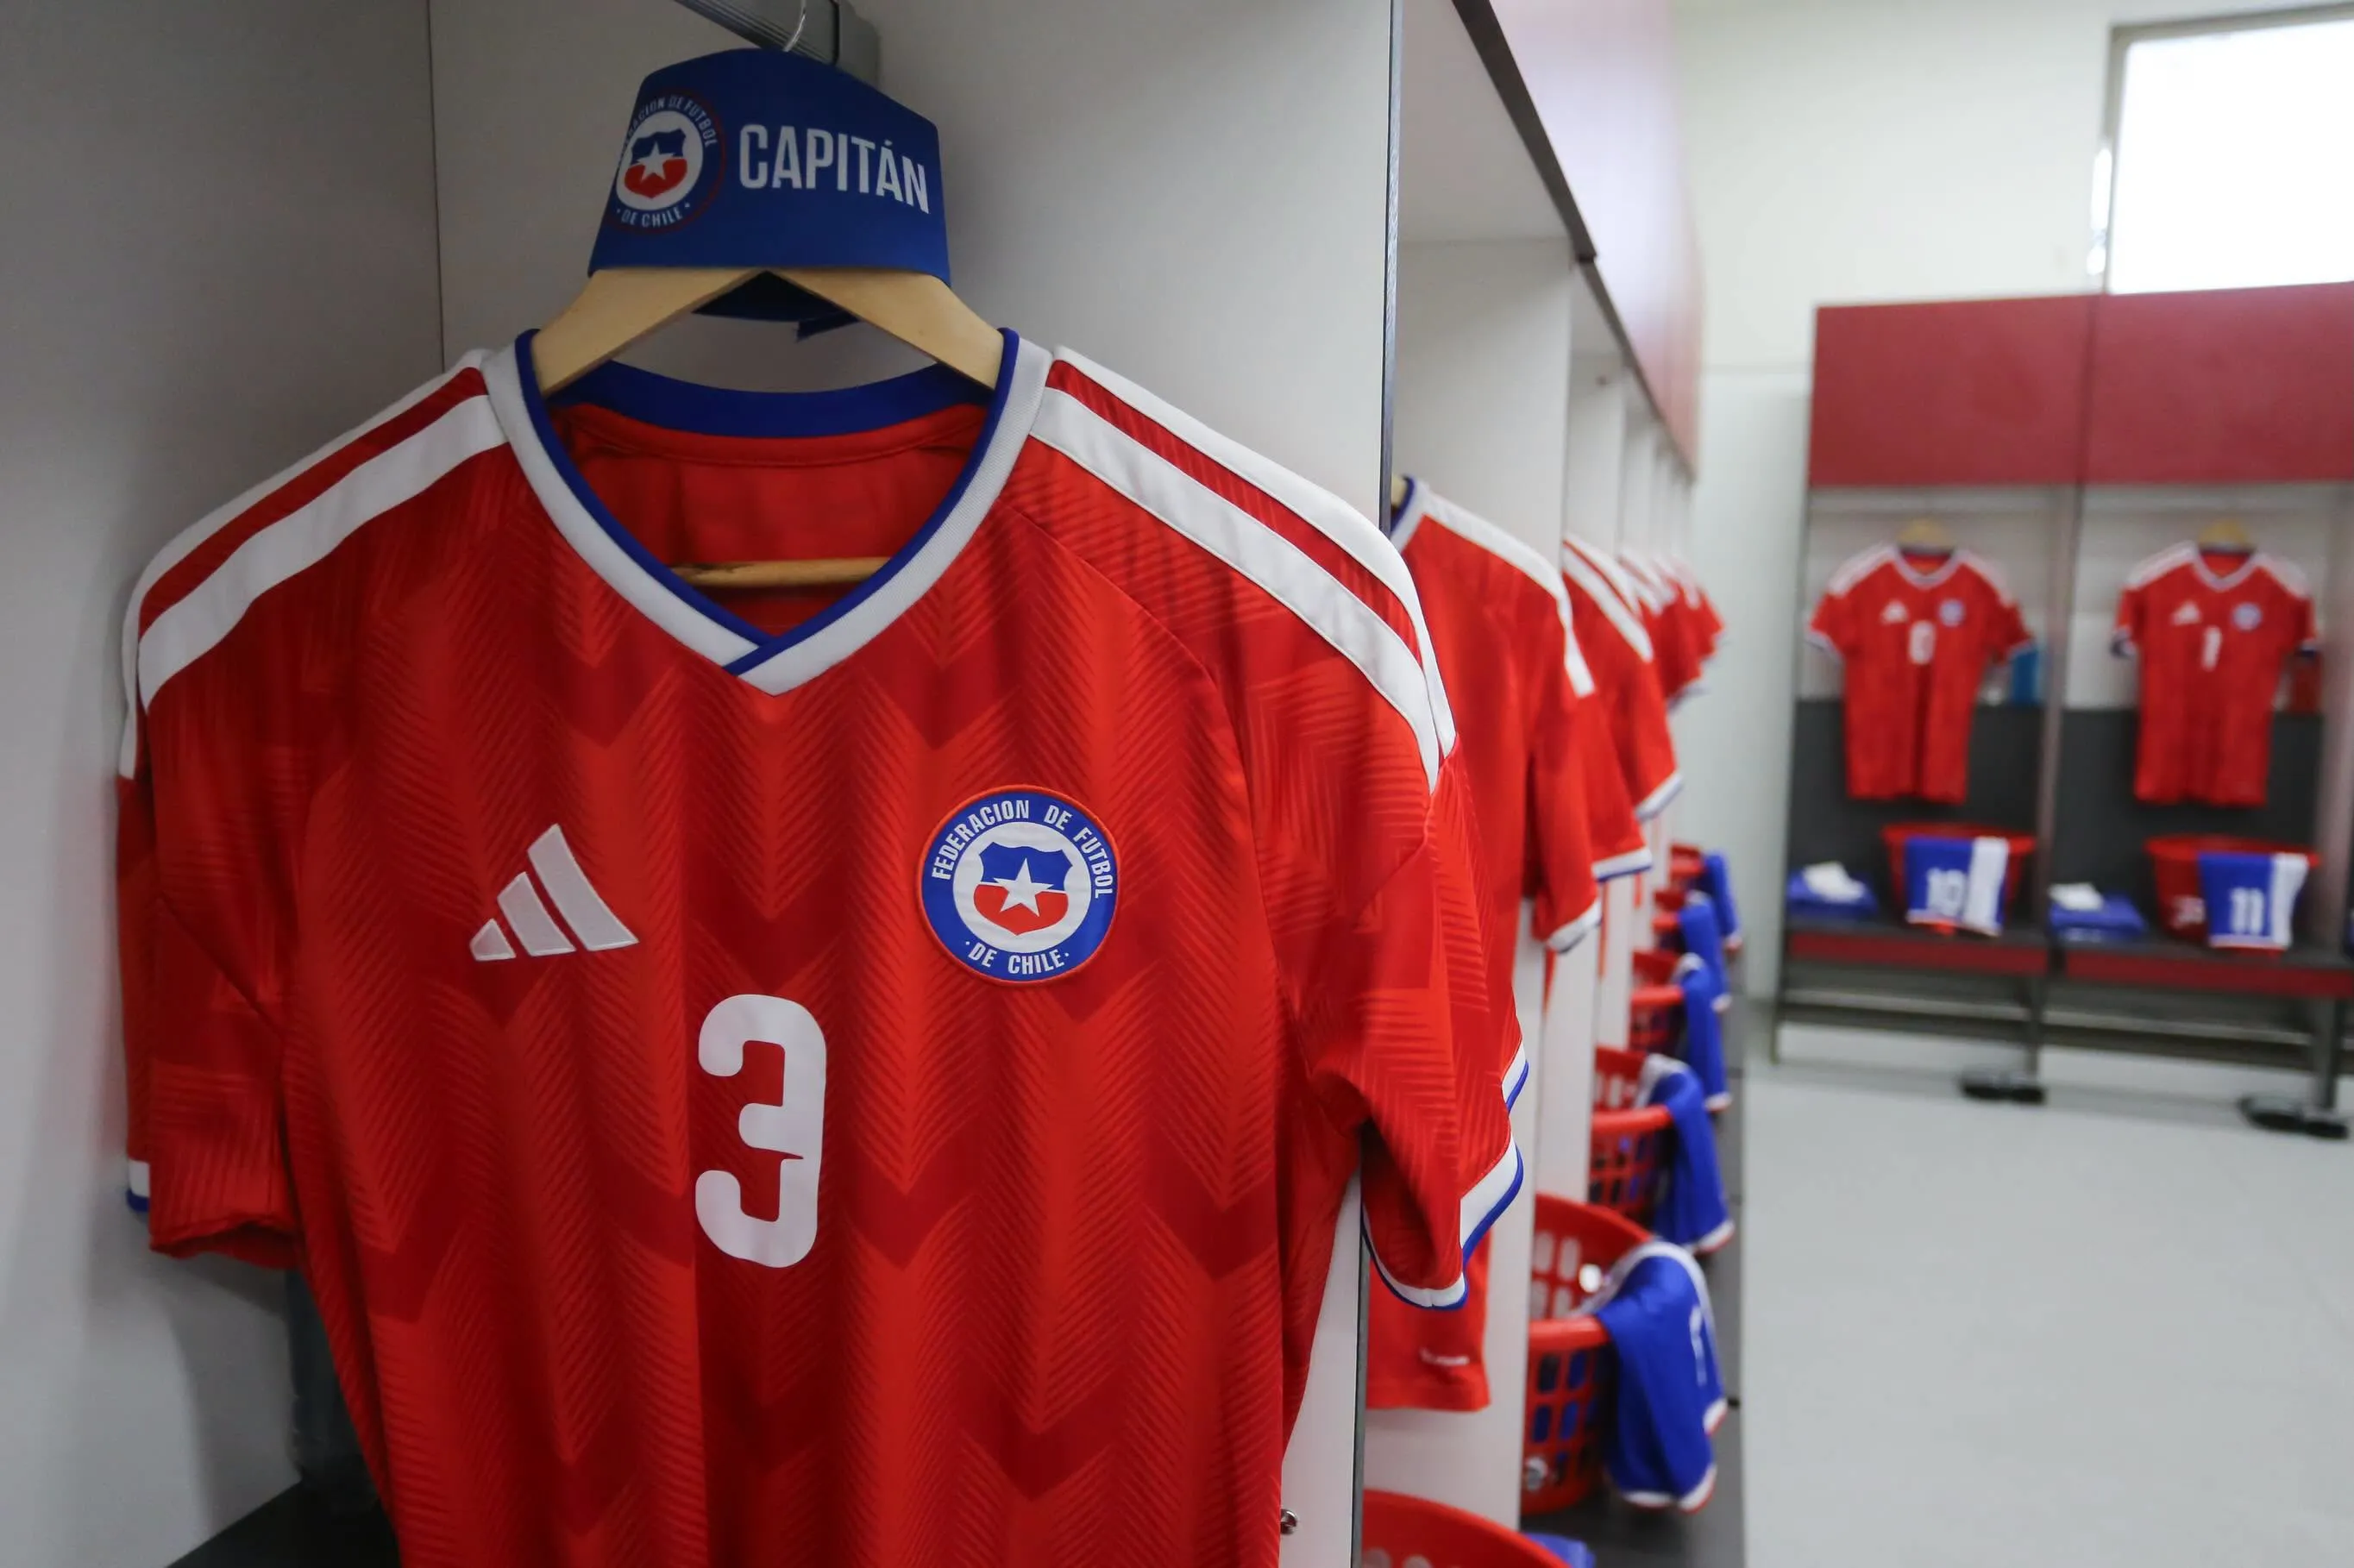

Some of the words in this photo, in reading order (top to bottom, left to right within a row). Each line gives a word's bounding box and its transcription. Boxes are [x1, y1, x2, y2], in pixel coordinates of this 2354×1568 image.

[668, 94, 682, 110] DE
[683, 99, 719, 147] FUTBOL
[739, 124, 930, 215] CAPITÁN
[621, 208, 638, 226] DE
[641, 206, 683, 229] CHILE
[932, 800, 1030, 881] FEDERACION
[1043, 804, 1073, 831] DE
[1072, 826, 1114, 899] FUTBOL
[968, 943, 998, 969] DE
[1008, 948, 1065, 975] CHILE
[695, 994, 828, 1269] 3
